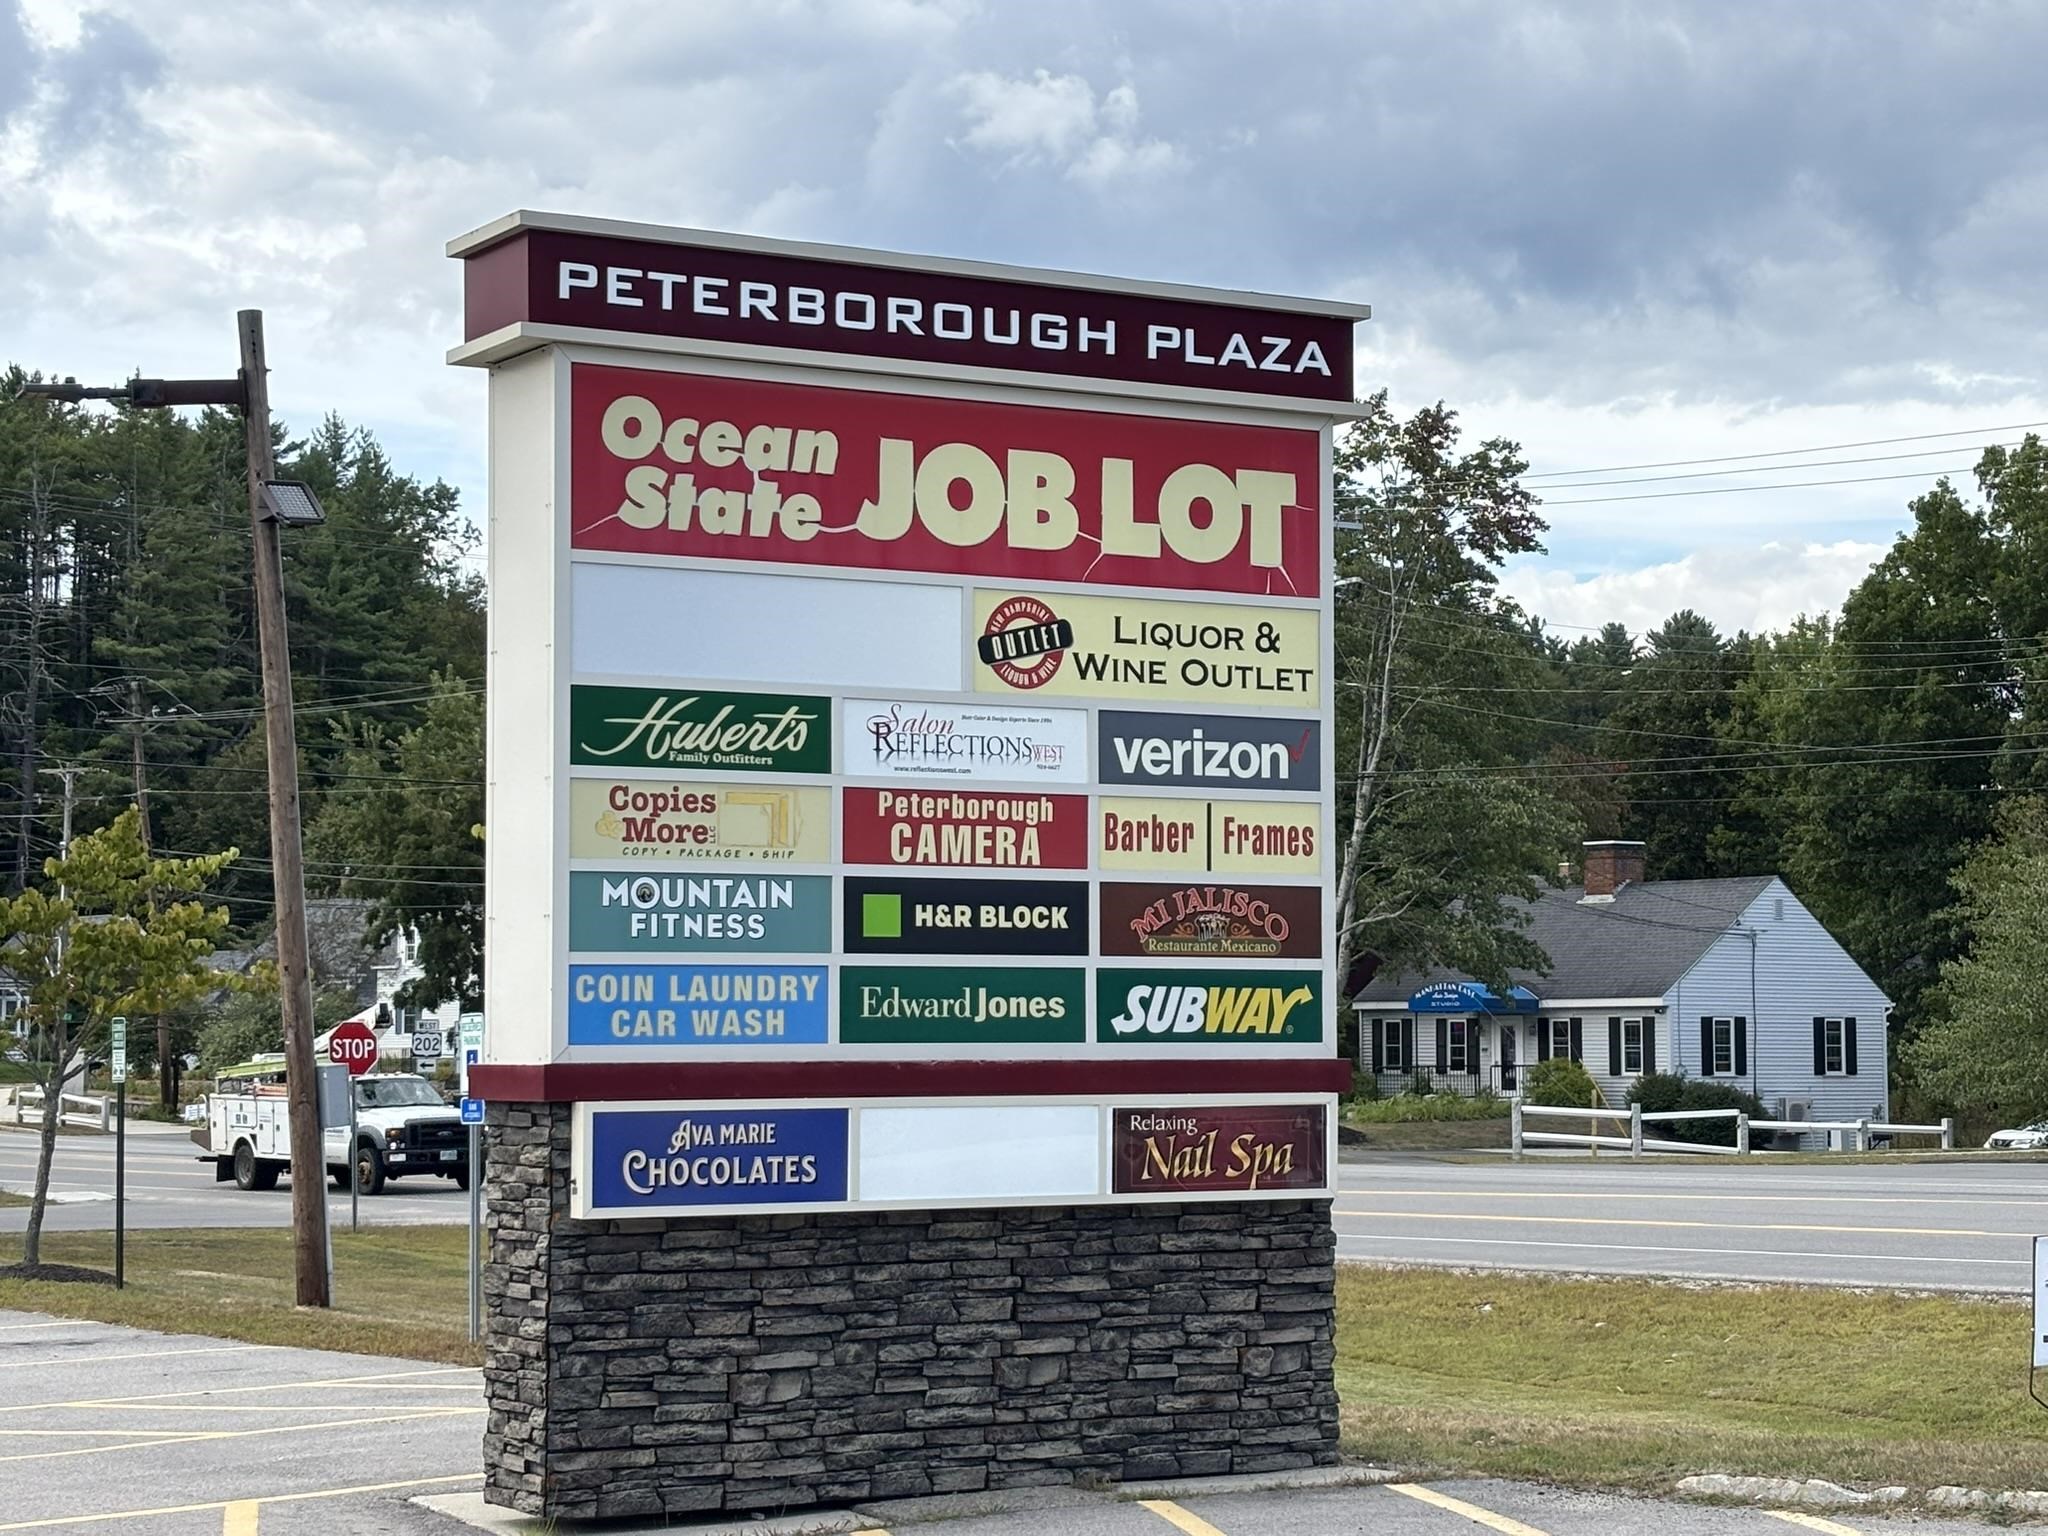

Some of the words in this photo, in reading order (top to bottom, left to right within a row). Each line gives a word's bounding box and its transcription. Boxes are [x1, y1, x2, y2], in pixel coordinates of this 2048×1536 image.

[558, 261, 1116, 355] PETERBOROUGH
[1147, 324, 1332, 376] PLAZA
[601, 395, 839, 475] Ocean
[617, 465, 822, 541] State
[856, 437, 1079, 551] JOB
[1101, 457, 1296, 567] LOT
[991, 623, 1061, 660] OUTLET
[1255, 621, 1281, 654] &
[1072, 652, 1168, 685] WINE
[1180, 658, 1314, 692] OUTLET
[581, 697, 818, 760] Hubert's
[867, 703, 954, 735] Salon
[669, 751, 710, 765] Family
[712, 752, 773, 765] Outfitters
[1113, 728, 1289, 779] verizon
[609, 785, 716, 817] Copies
[878, 791, 1054, 826] Peterborough
[622, 817, 709, 844] More
[891, 822, 1041, 866] CAMERA
[1104, 812, 1194, 853] Barber
[1223, 816, 1314, 857] Frames
[622, 847, 658, 856] COPY
[680, 848, 741, 858] PACKAGE
[762, 850, 795, 860] SHIP
[602, 876, 794, 909] MOUNTAIN
[631, 913, 766, 939] FITNESS
[915, 904, 972, 928] H&R
[979, 905, 1069, 929] BLOCK
[1130, 898, 1173, 943] MI
[1172, 886, 1289, 941] JALISCO
[1148, 938, 1218, 953] Restaurante
[1220, 939, 1276, 953] Mexicano
[575, 974, 654, 1003] COIN
[670, 975, 820, 1002] LAUNDRY
[418, 1022, 437, 1030] WEST
[611, 1009, 676, 1037] CAR
[692, 1009, 785, 1036] WASH
[1110, 983, 1314, 1036] SUBWAY
[331, 1038, 375, 1060] STOP
[414, 1037, 440, 1051] 202
[667, 1119, 715, 1155] AVA
[719, 1122, 776, 1145] MARIE
[1130, 1115, 1198, 1136] Relaxing
[622, 1149, 817, 1194] CHOCOLATES
[1141, 1129, 1219, 1181] Nail
[1225, 1133, 1295, 1190] Spa
